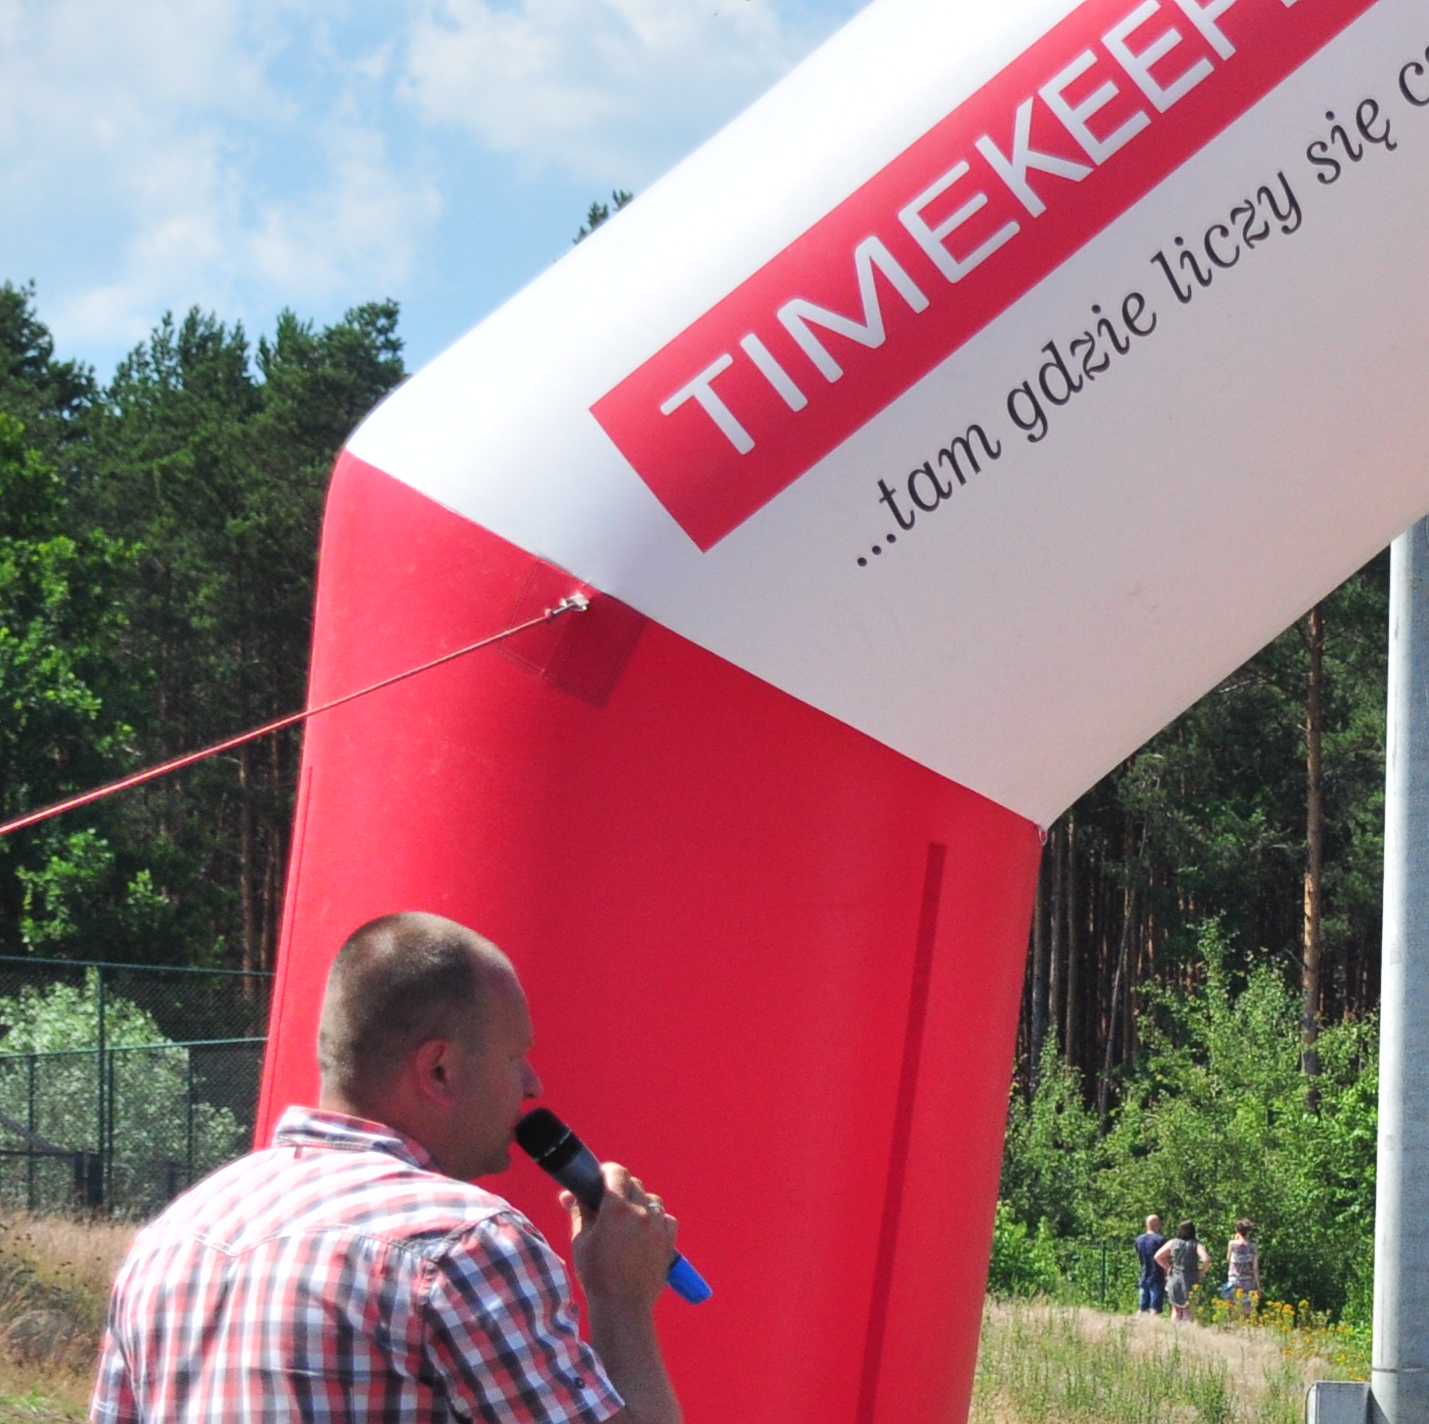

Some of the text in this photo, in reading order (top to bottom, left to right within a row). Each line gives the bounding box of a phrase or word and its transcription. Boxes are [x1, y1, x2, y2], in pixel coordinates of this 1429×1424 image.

[660, 0, 1299, 455] TIMEKEEP
[1006, 291, 1158, 443] gdzie
[1150, 171, 1302, 304] liczy
[1306, 98, 1398, 184] się
